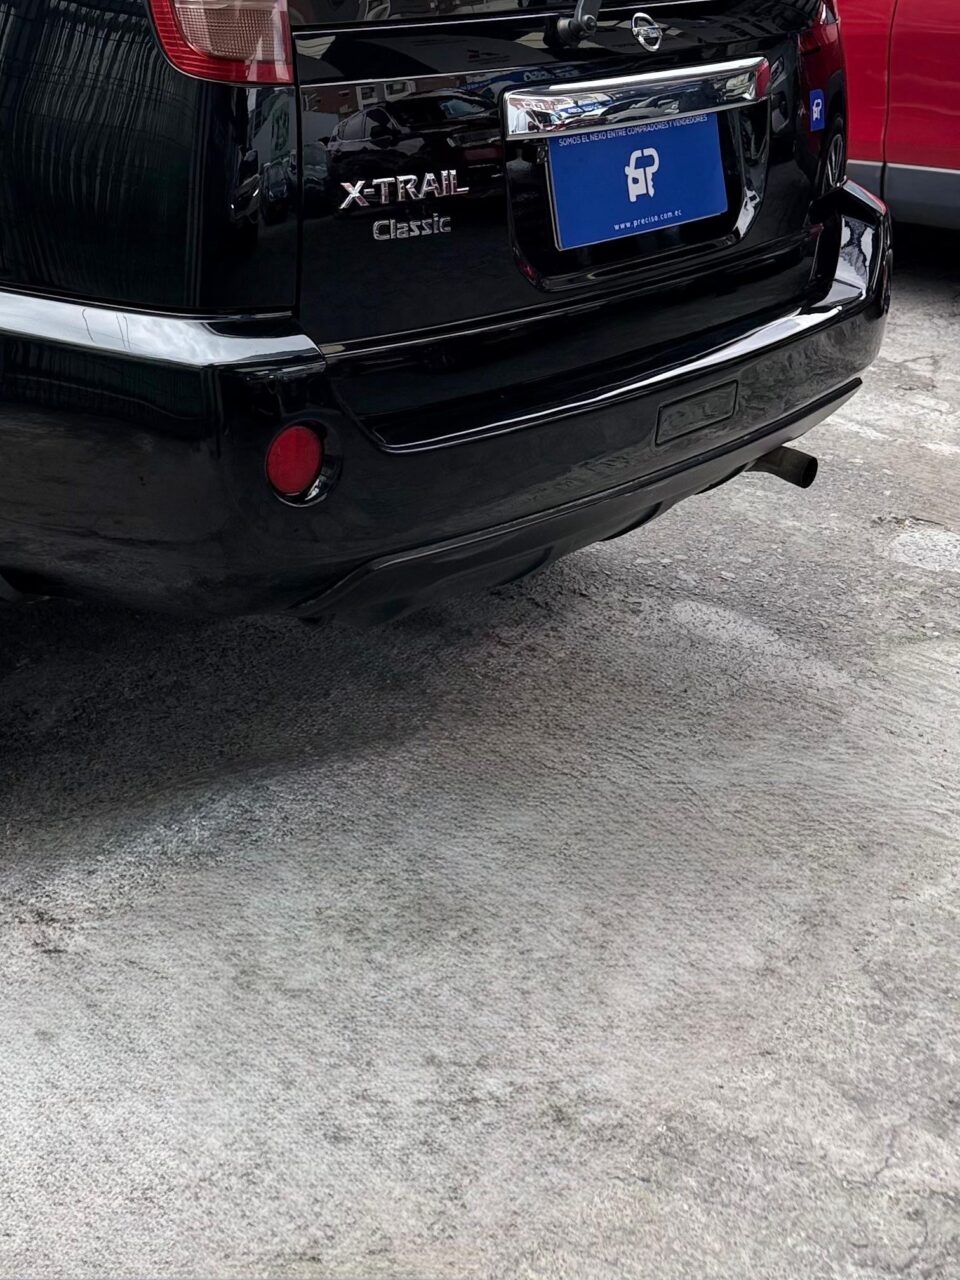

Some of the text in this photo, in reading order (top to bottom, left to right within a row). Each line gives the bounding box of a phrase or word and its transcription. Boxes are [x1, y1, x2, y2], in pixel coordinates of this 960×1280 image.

[559, 135, 581, 147] SOMOS
[582, 134, 590, 143] EL
[590, 131, 607, 141] NEXO
[607, 128, 627, 139] ENTRE
[627, 121, 669, 135] COMPRADORES
[672, 114, 708, 127] VENDEDORES
[339, 170, 470, 209] X-TRAIL
[373, 213, 451, 240] Classic
[614, 209, 682, 230] www.preciso.com.ec
